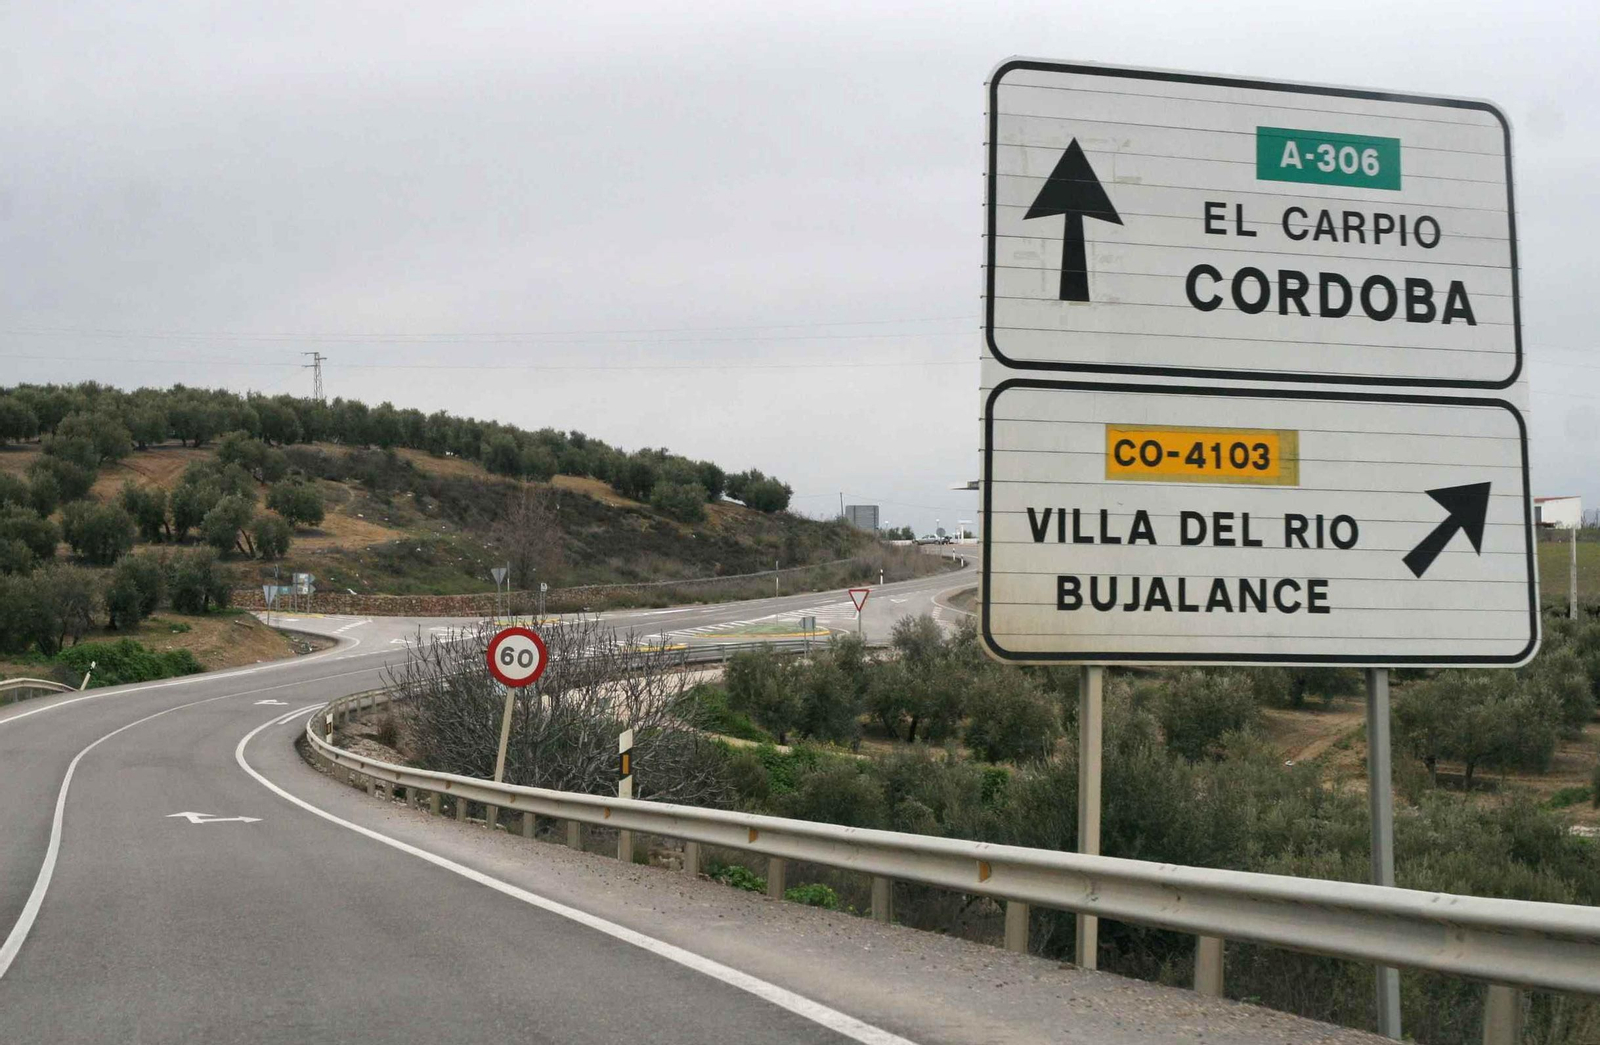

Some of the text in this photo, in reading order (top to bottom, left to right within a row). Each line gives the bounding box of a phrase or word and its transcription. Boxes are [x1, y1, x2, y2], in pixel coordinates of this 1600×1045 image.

[1280, 140, 1380, 176] A-306
[1204, 201, 1441, 249] EL CARPIO
[1185, 264, 1477, 326] CORDOBA
[1114, 439, 1270, 470] CO-4103
[1027, 507, 1359, 550] VILLA DEL RIO
[1058, 575, 1331, 614] BUJALANCE
[500, 646, 534, 668] 60
